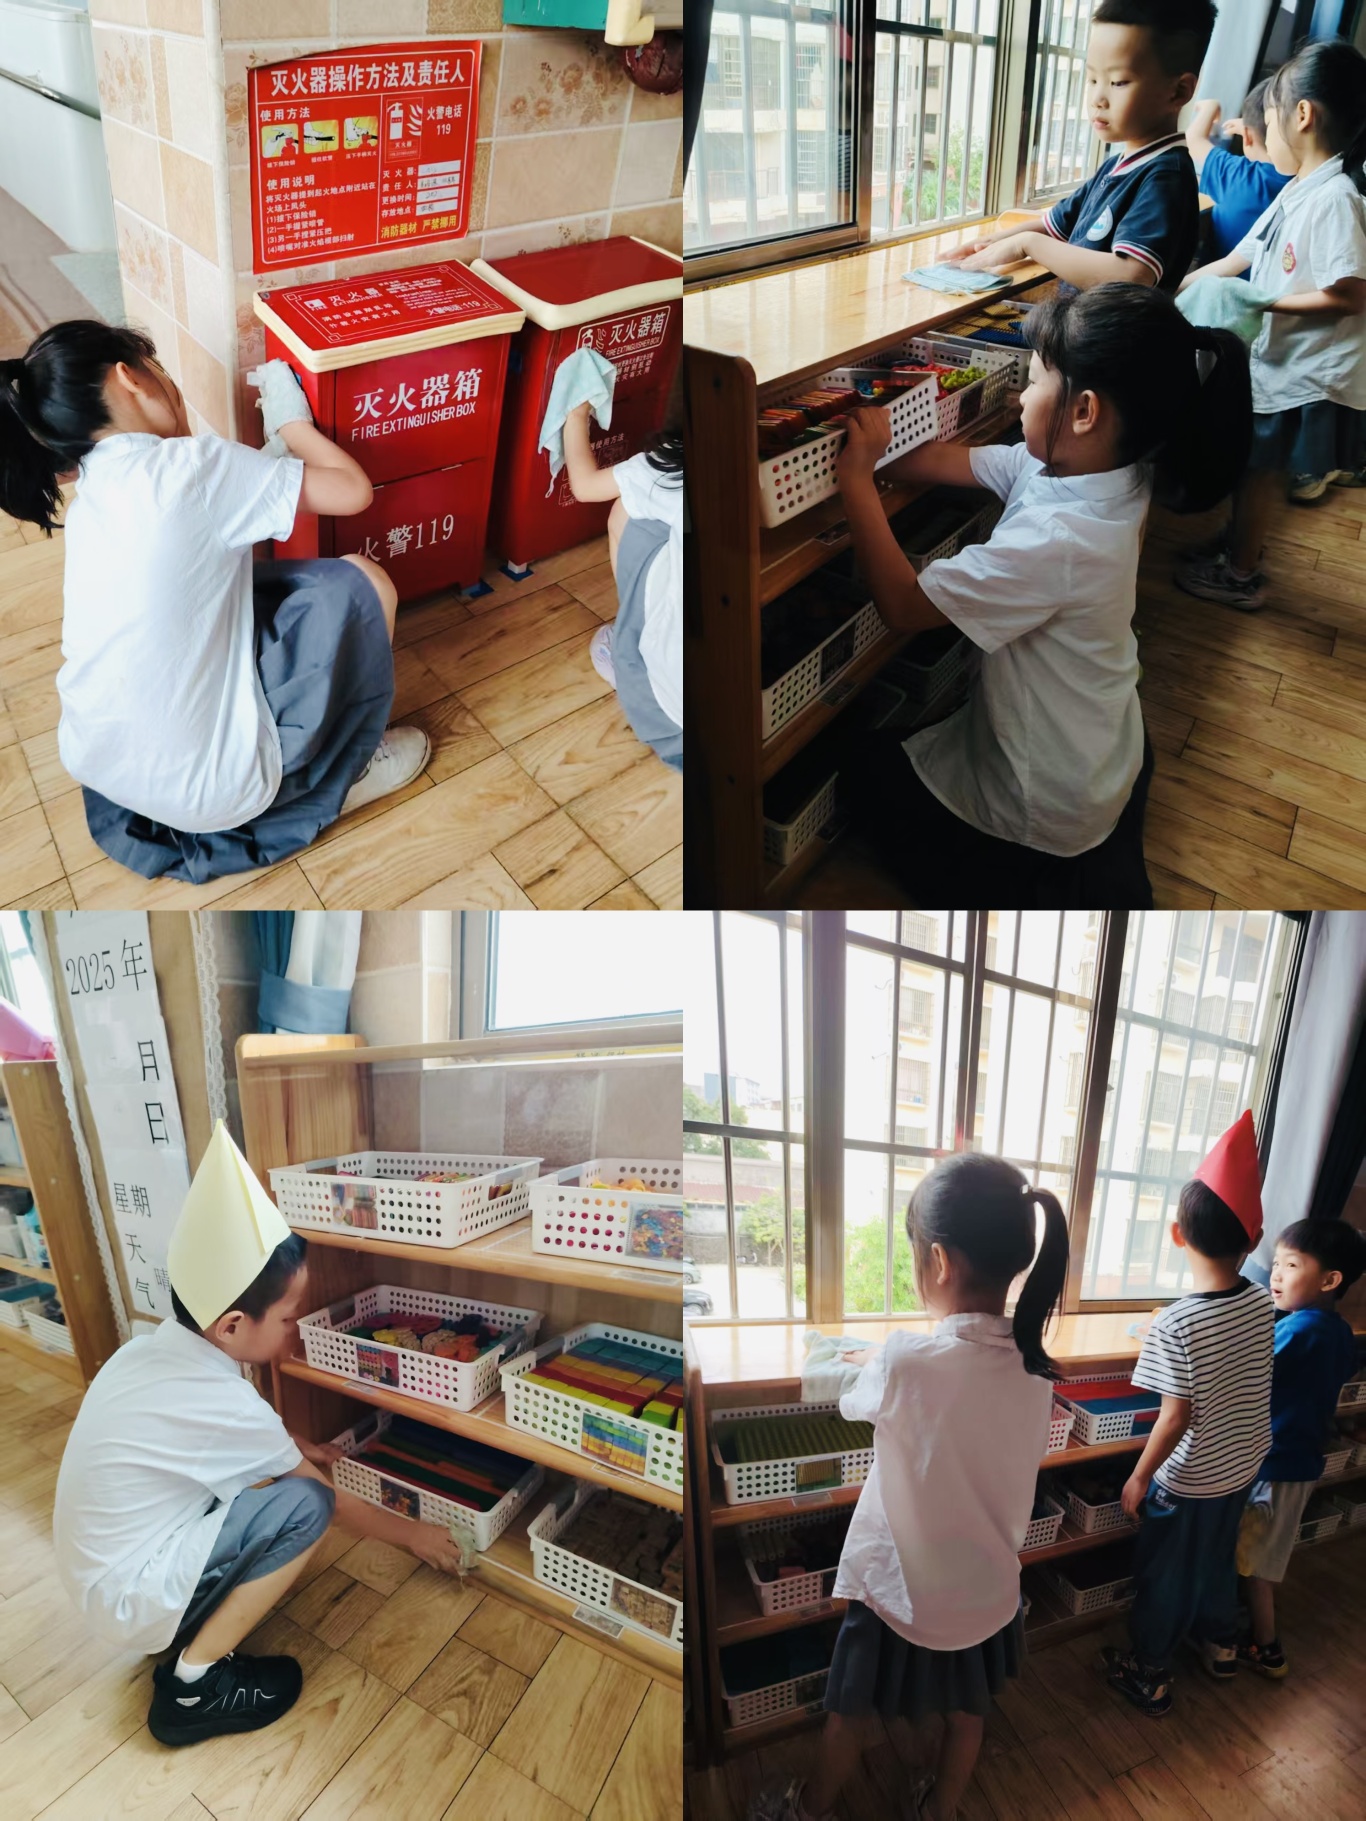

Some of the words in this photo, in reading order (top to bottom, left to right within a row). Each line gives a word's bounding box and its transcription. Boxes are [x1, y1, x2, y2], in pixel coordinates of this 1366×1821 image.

[270, 59, 465, 97] 灭火器操作方法及责任人
[260, 107, 310, 122] 使用方法
[427, 104, 462, 120] 火警电话
[436, 123, 451, 136] 119
[265, 181, 376, 204] 将灭火器提到起火地点附近站在
[267, 174, 315, 191] 使用说明
[266, 201, 307, 214] 火场上风头
[381, 221, 417, 239] 消防器材
[422, 214, 457, 231] 严禁挪用
[608, 312, 667, 346] 灭火器箱
[605, 347, 617, 357] FIRE
[352, 368, 483, 424] 灭火器箱
[351, 423, 380, 442] FIRE
[382, 406, 455, 436] EXTINGUISHER
[455, 401, 476, 417] BOX
[357, 514, 454, 563] 火警119
[137, 1040, 160, 1082] 月
[144, 1101, 169, 1145] 日
[113, 1182, 151, 1218] 星期
[153, 1267, 171, 1293] 晴
